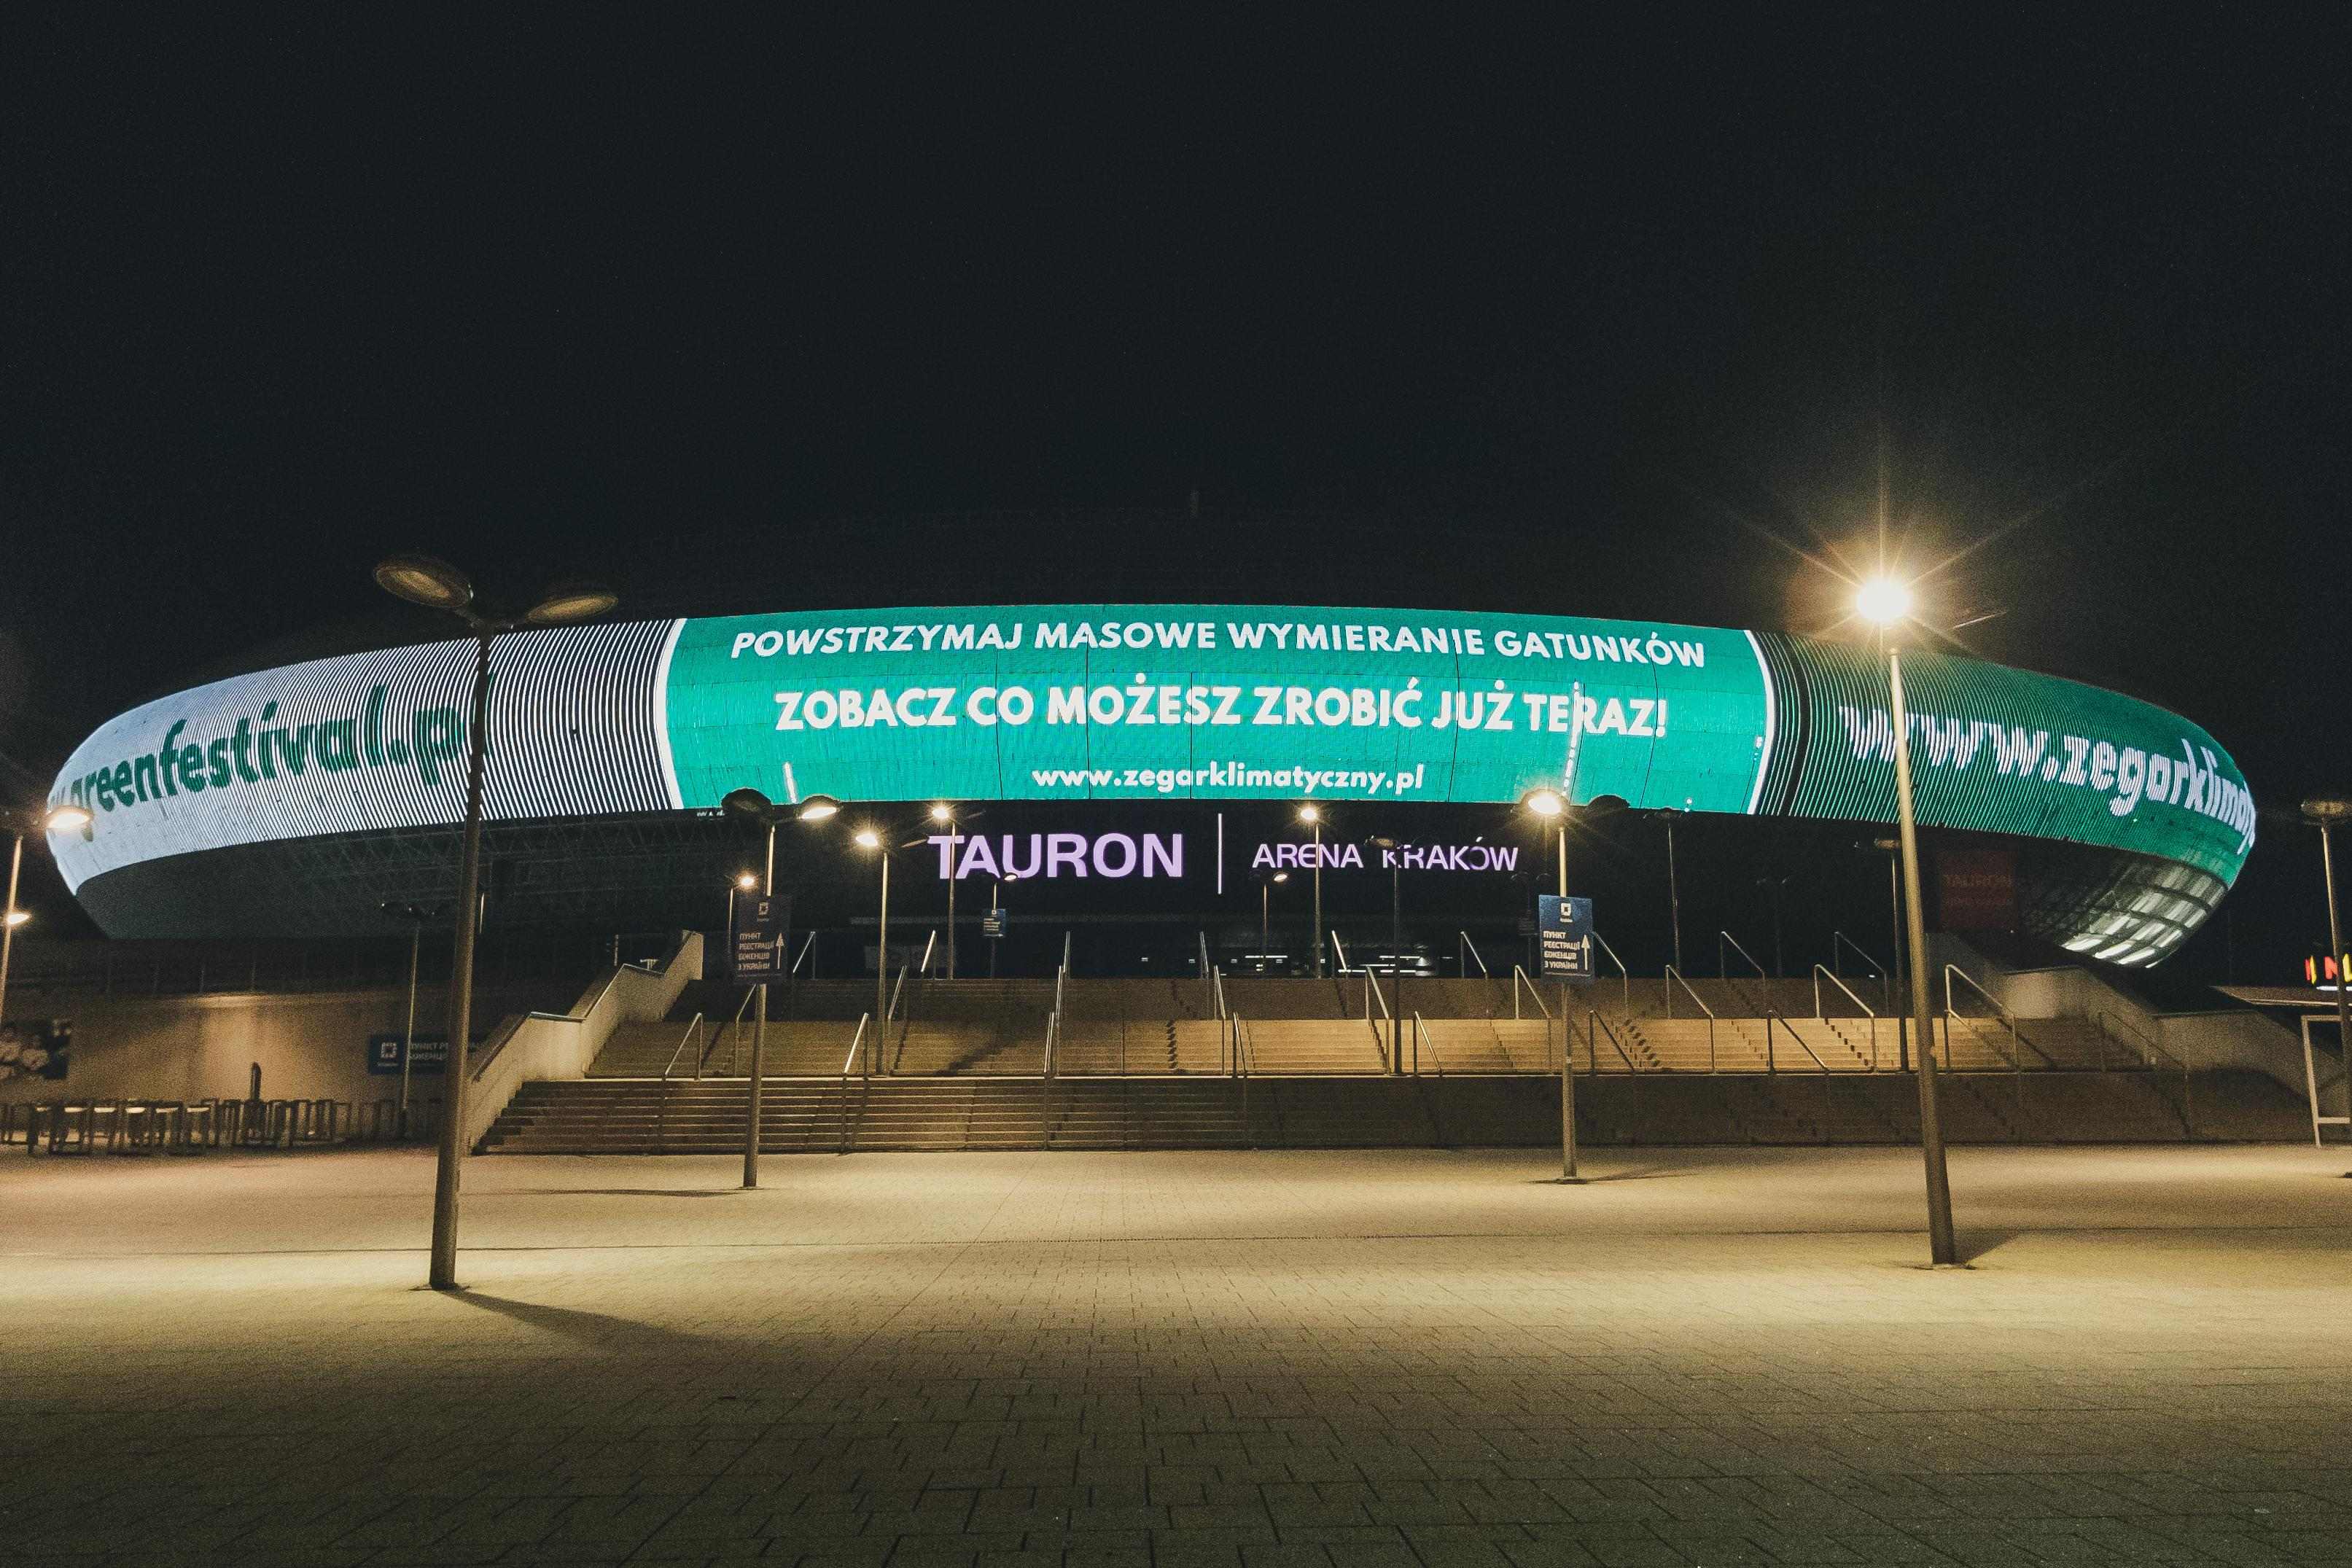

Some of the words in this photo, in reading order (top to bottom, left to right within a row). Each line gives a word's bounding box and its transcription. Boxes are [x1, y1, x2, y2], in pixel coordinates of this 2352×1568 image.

[731, 623, 1022, 658] POWSTRZYMAJ
[1035, 622, 1215, 649] MASOWE
[1227, 623, 1484, 655] WYMIERANIE
[1494, 631, 1705, 668] GATUNKÓW
[774, 687, 957, 730] ZOBACZ
[967, 687, 1034, 725] CO
[1047, 673, 1242, 725] MOŻESZ
[1252, 677, 1422, 728] ZROBIĆ
[1431, 680, 1516, 730] JUŻ
[1523, 693, 1667, 737] TERAZ!
[1032, 761, 1425, 795] www.zegarklimatyczny.pl
[928, 834, 1182, 879] TAURON
[1252, 843, 1364, 869] ARENA
[1382, 836, 1519, 871] KRAKÓW
